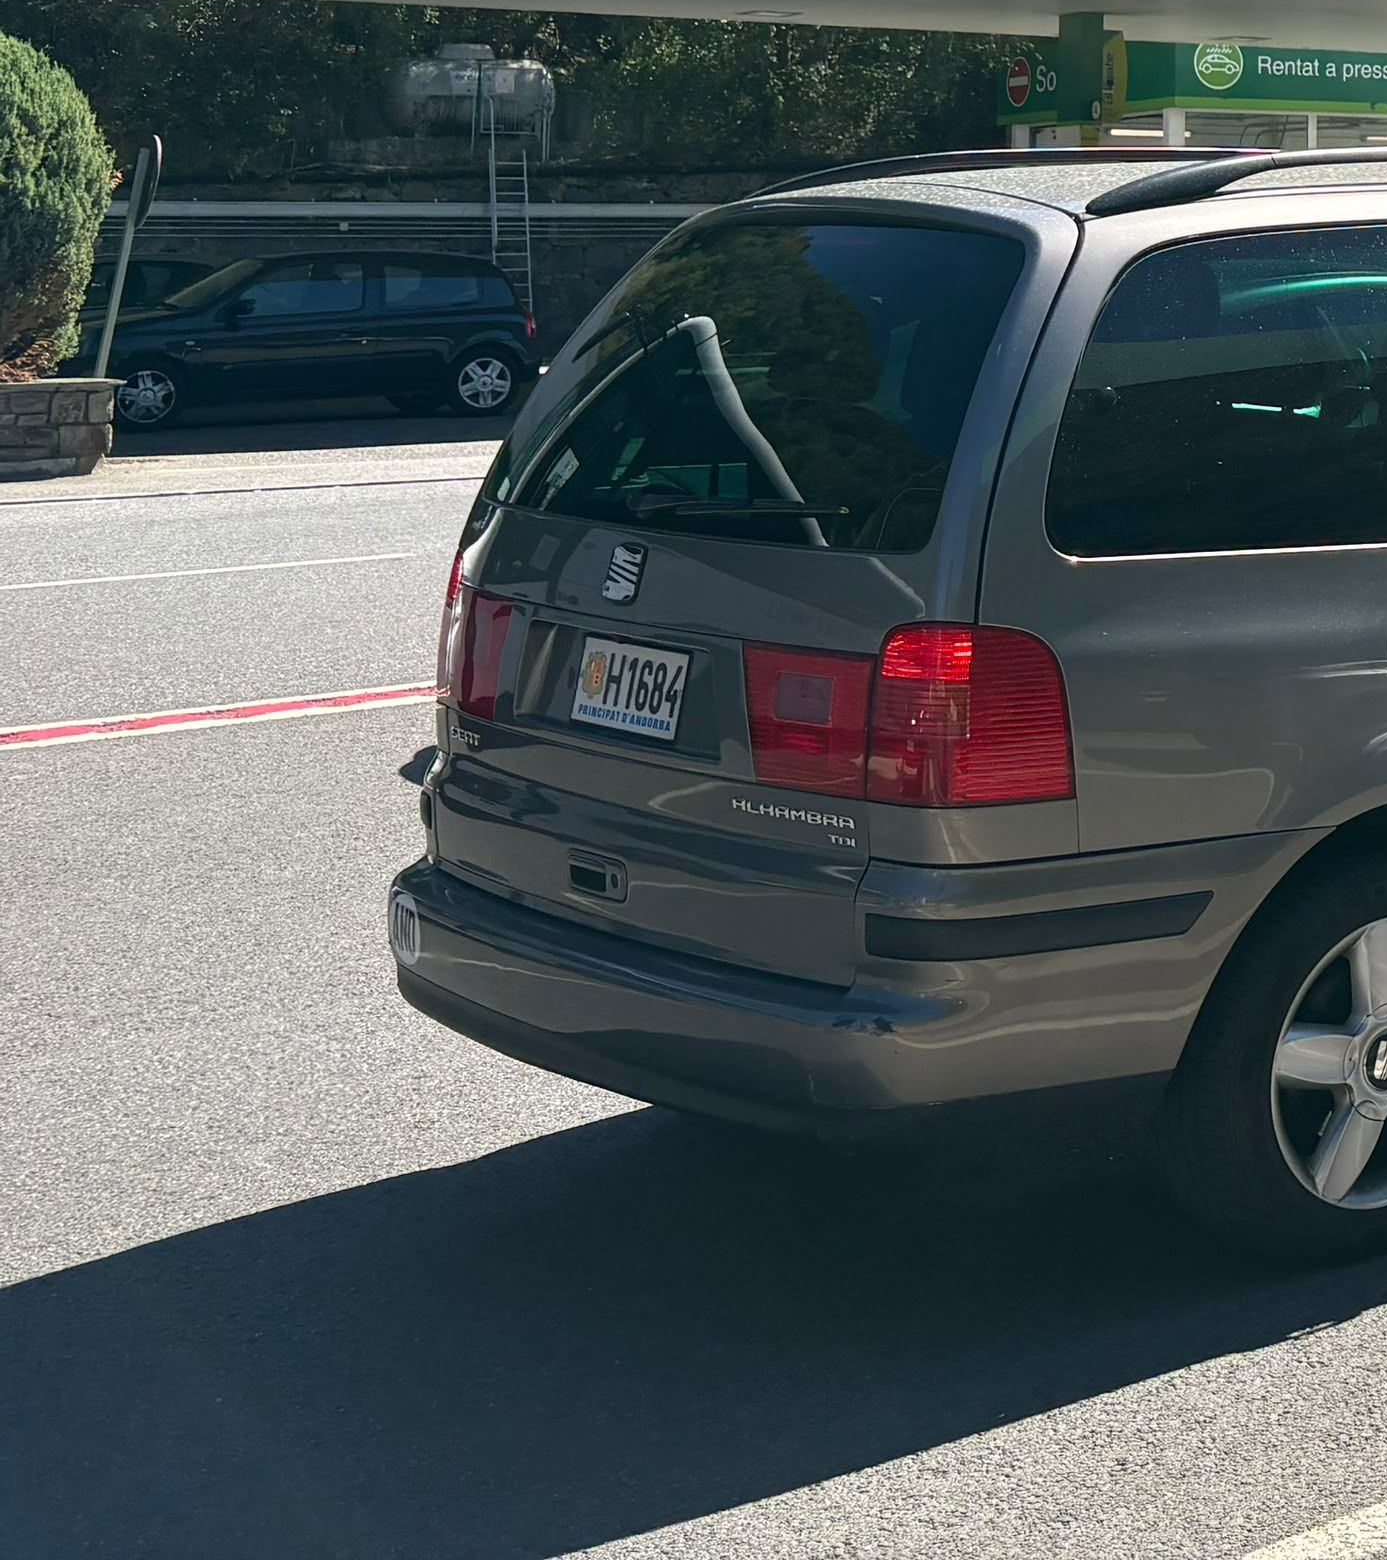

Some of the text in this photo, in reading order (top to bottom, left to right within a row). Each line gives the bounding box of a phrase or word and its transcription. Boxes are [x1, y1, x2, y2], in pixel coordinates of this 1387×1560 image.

[1257, 55, 1320, 77] Rentat
[1325, 62, 1337, 77] a
[601, 652, 684, 719] H1684
[577, 703, 672, 733] PRINCIPAT D'ANDORRA
[450, 725, 481, 747] SEAT
[731, 798, 856, 830] ALHAMBRA
[827, 834, 857, 848] TDI
